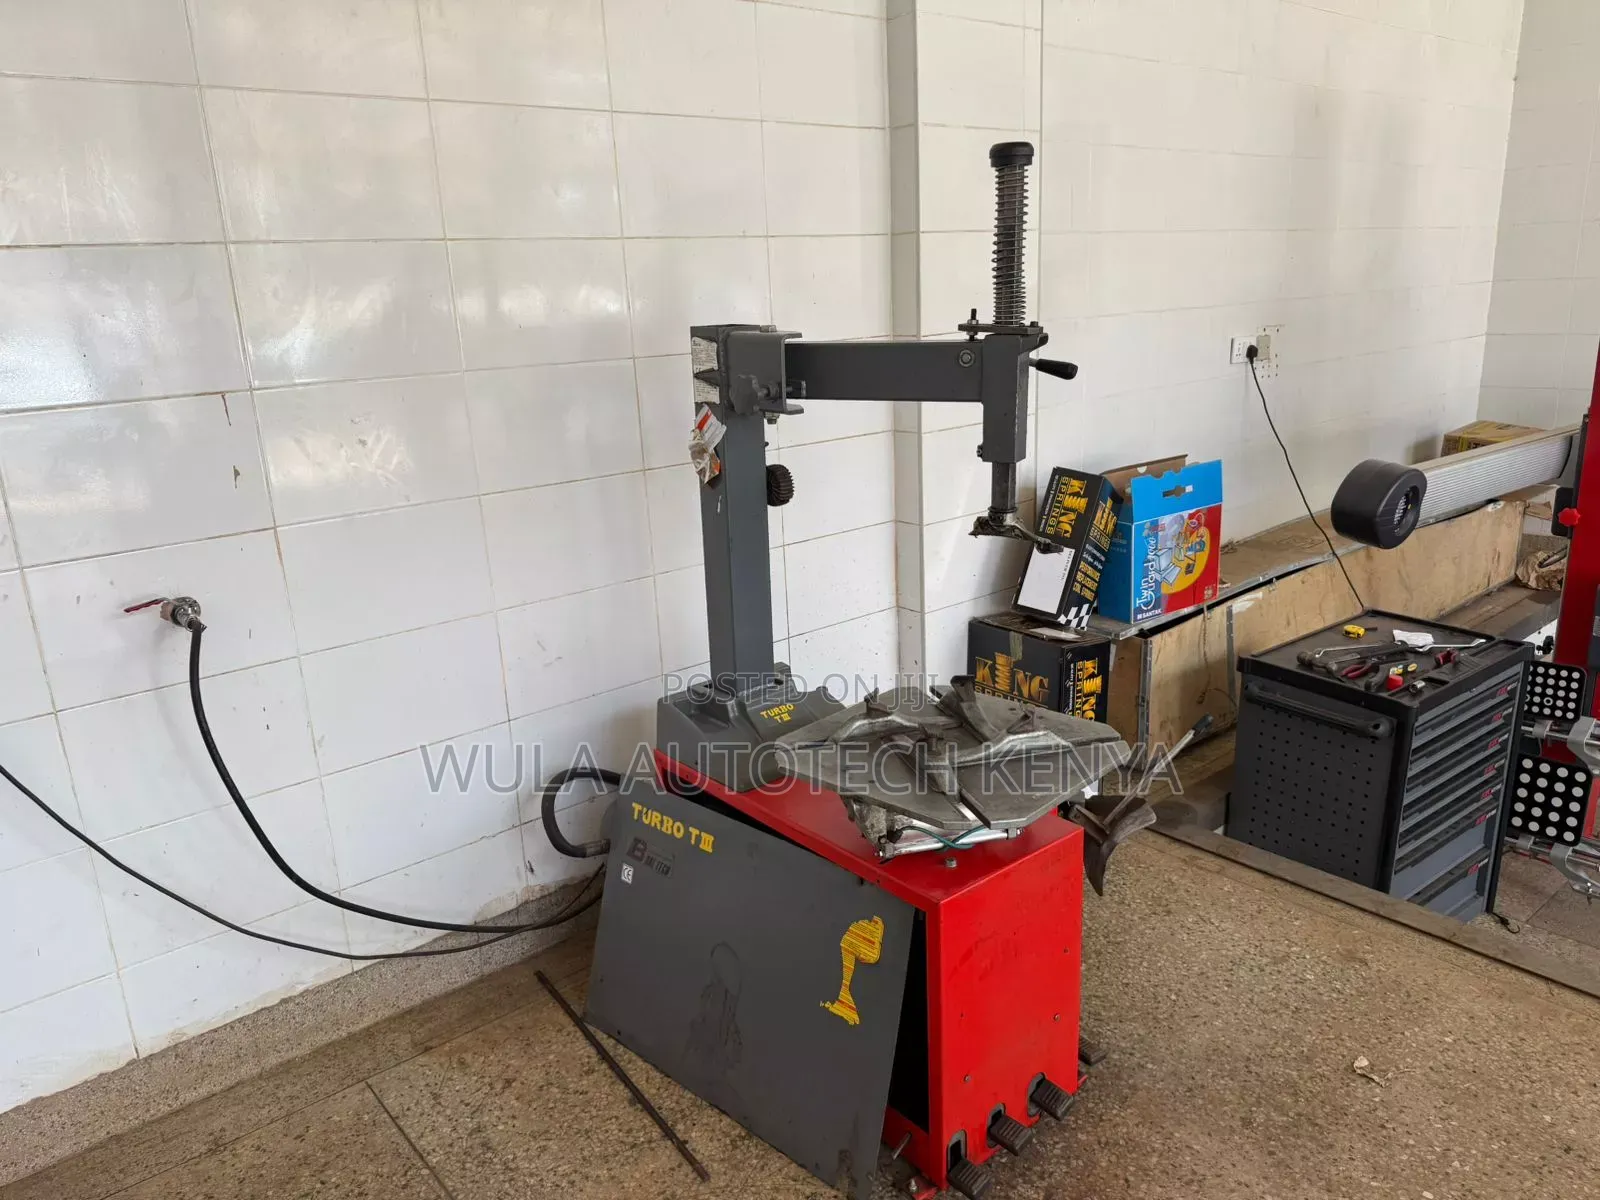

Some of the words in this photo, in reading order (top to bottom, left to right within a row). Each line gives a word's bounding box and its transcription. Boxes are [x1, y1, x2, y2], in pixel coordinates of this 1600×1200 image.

[1075, 661, 1083, 718] SPRING
[760, 703, 794, 719] TURBO
[632, 802, 685, 838] TURBO
